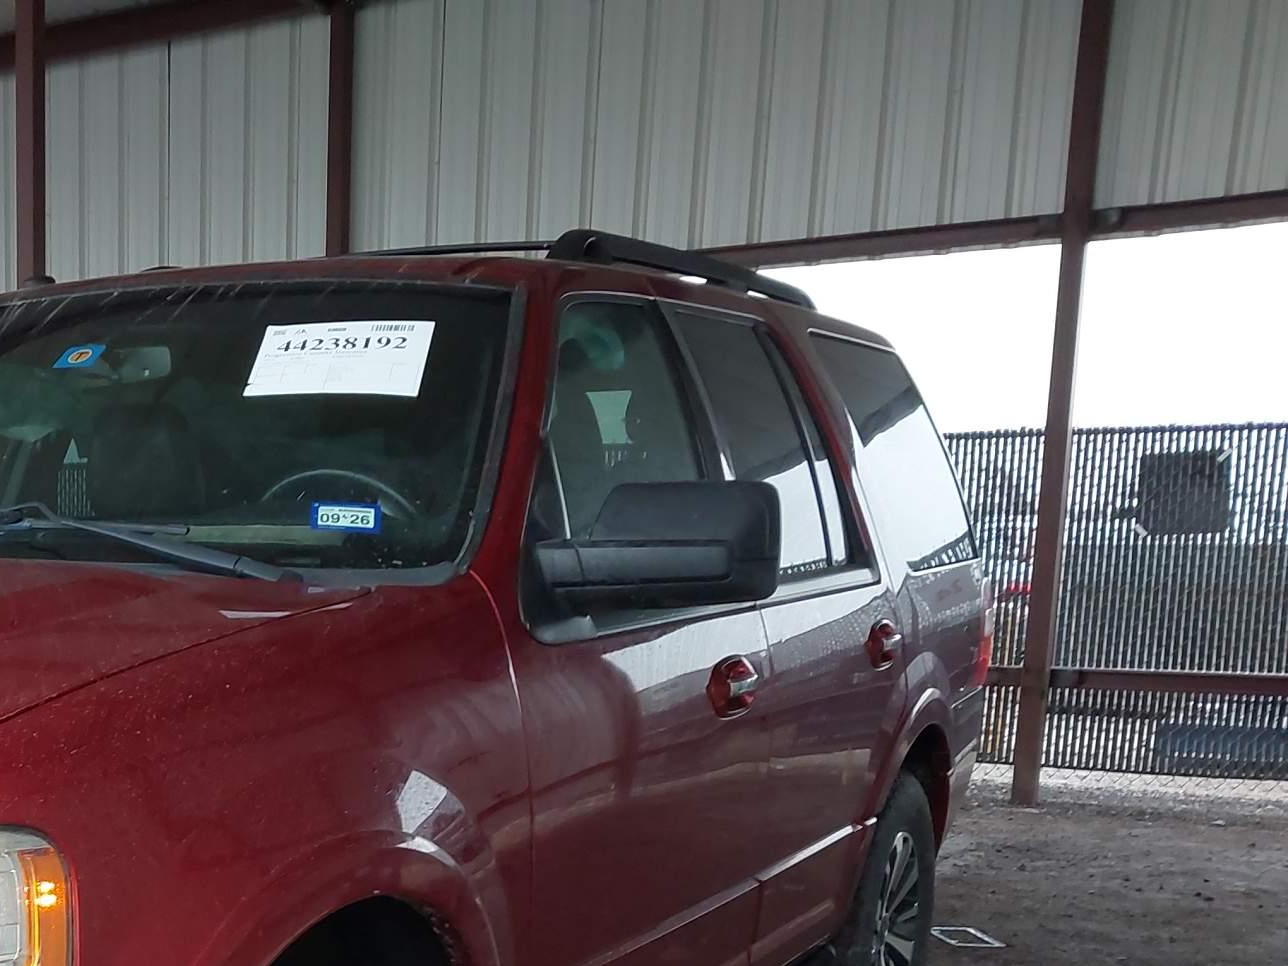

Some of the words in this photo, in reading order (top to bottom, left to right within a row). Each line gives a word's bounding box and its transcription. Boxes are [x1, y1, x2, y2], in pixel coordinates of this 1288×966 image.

[276, 335, 409, 353] 44238192
[319, 513, 341, 524] 09
[350, 513, 371, 525] 26
